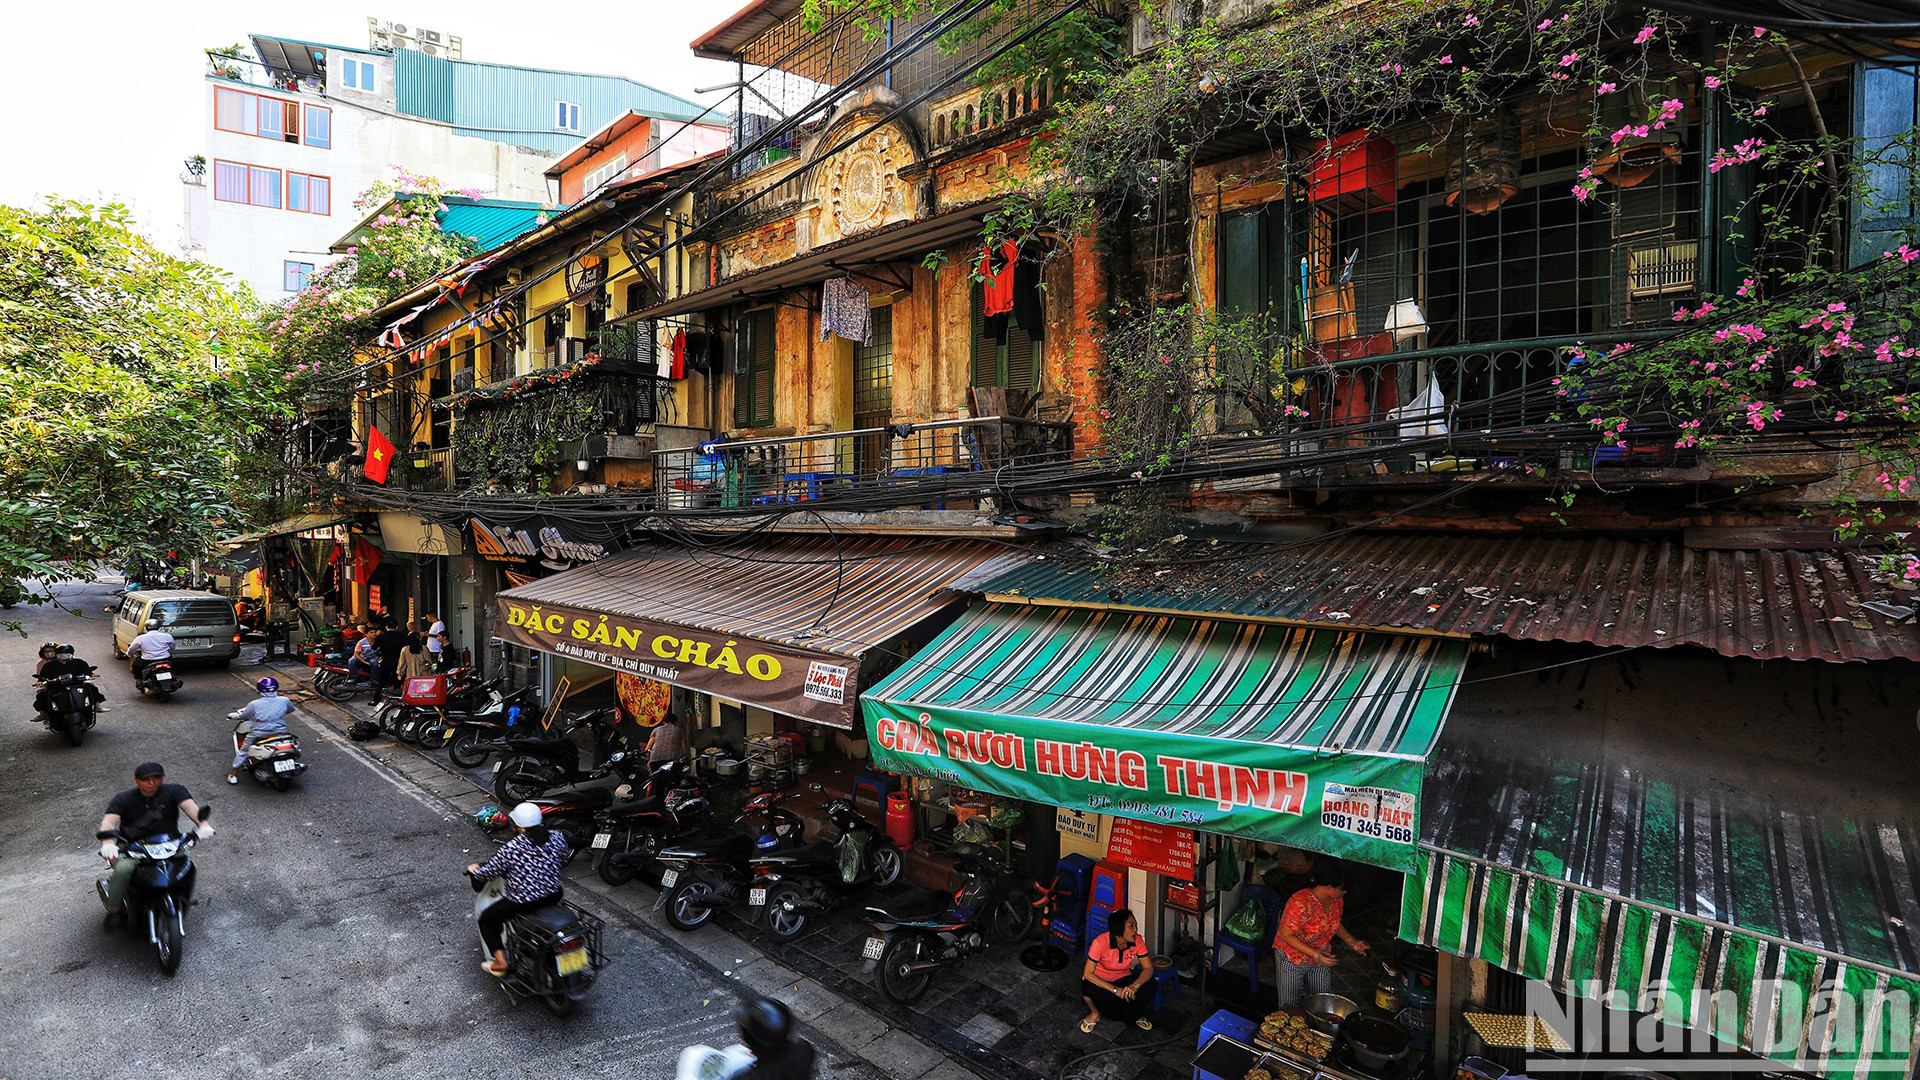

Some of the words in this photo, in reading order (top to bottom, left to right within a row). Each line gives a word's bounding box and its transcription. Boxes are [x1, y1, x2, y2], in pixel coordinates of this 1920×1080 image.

[507, 604, 565, 635] ĐẶC
[571, 614, 643, 651] SẢN
[651, 635, 782, 681] CHÁO
[583, 649, 598, 660] DUY
[612, 656, 624, 670] ĐỊA
[639, 661, 656, 676] DUY
[656, 666, 680, 681] NHẤT
[877, 713, 941, 757] CHẢ
[944, 728, 1027, 771] RƯƠI
[1034, 739, 1149, 790] HƯNG
[1157, 754, 1308, 817] THỊNH
[928, 766, 960, 781] Chiếu
[1072, 818, 1085, 829] DUY
[1088, 794, 1115, 811] ĐT:
[1118, 799, 1150, 814] 0903
[1152, 804, 1176, 820] 481
[1178, 809, 1204, 825] 584
[1373, 805, 1412, 826] PHÁT
[1322, 813, 1352, 830] 0981
[1357, 819, 1381, 836] 345
[1385, 825, 1412, 842] 568
[1143, 860, 1157, 868] SHIP
